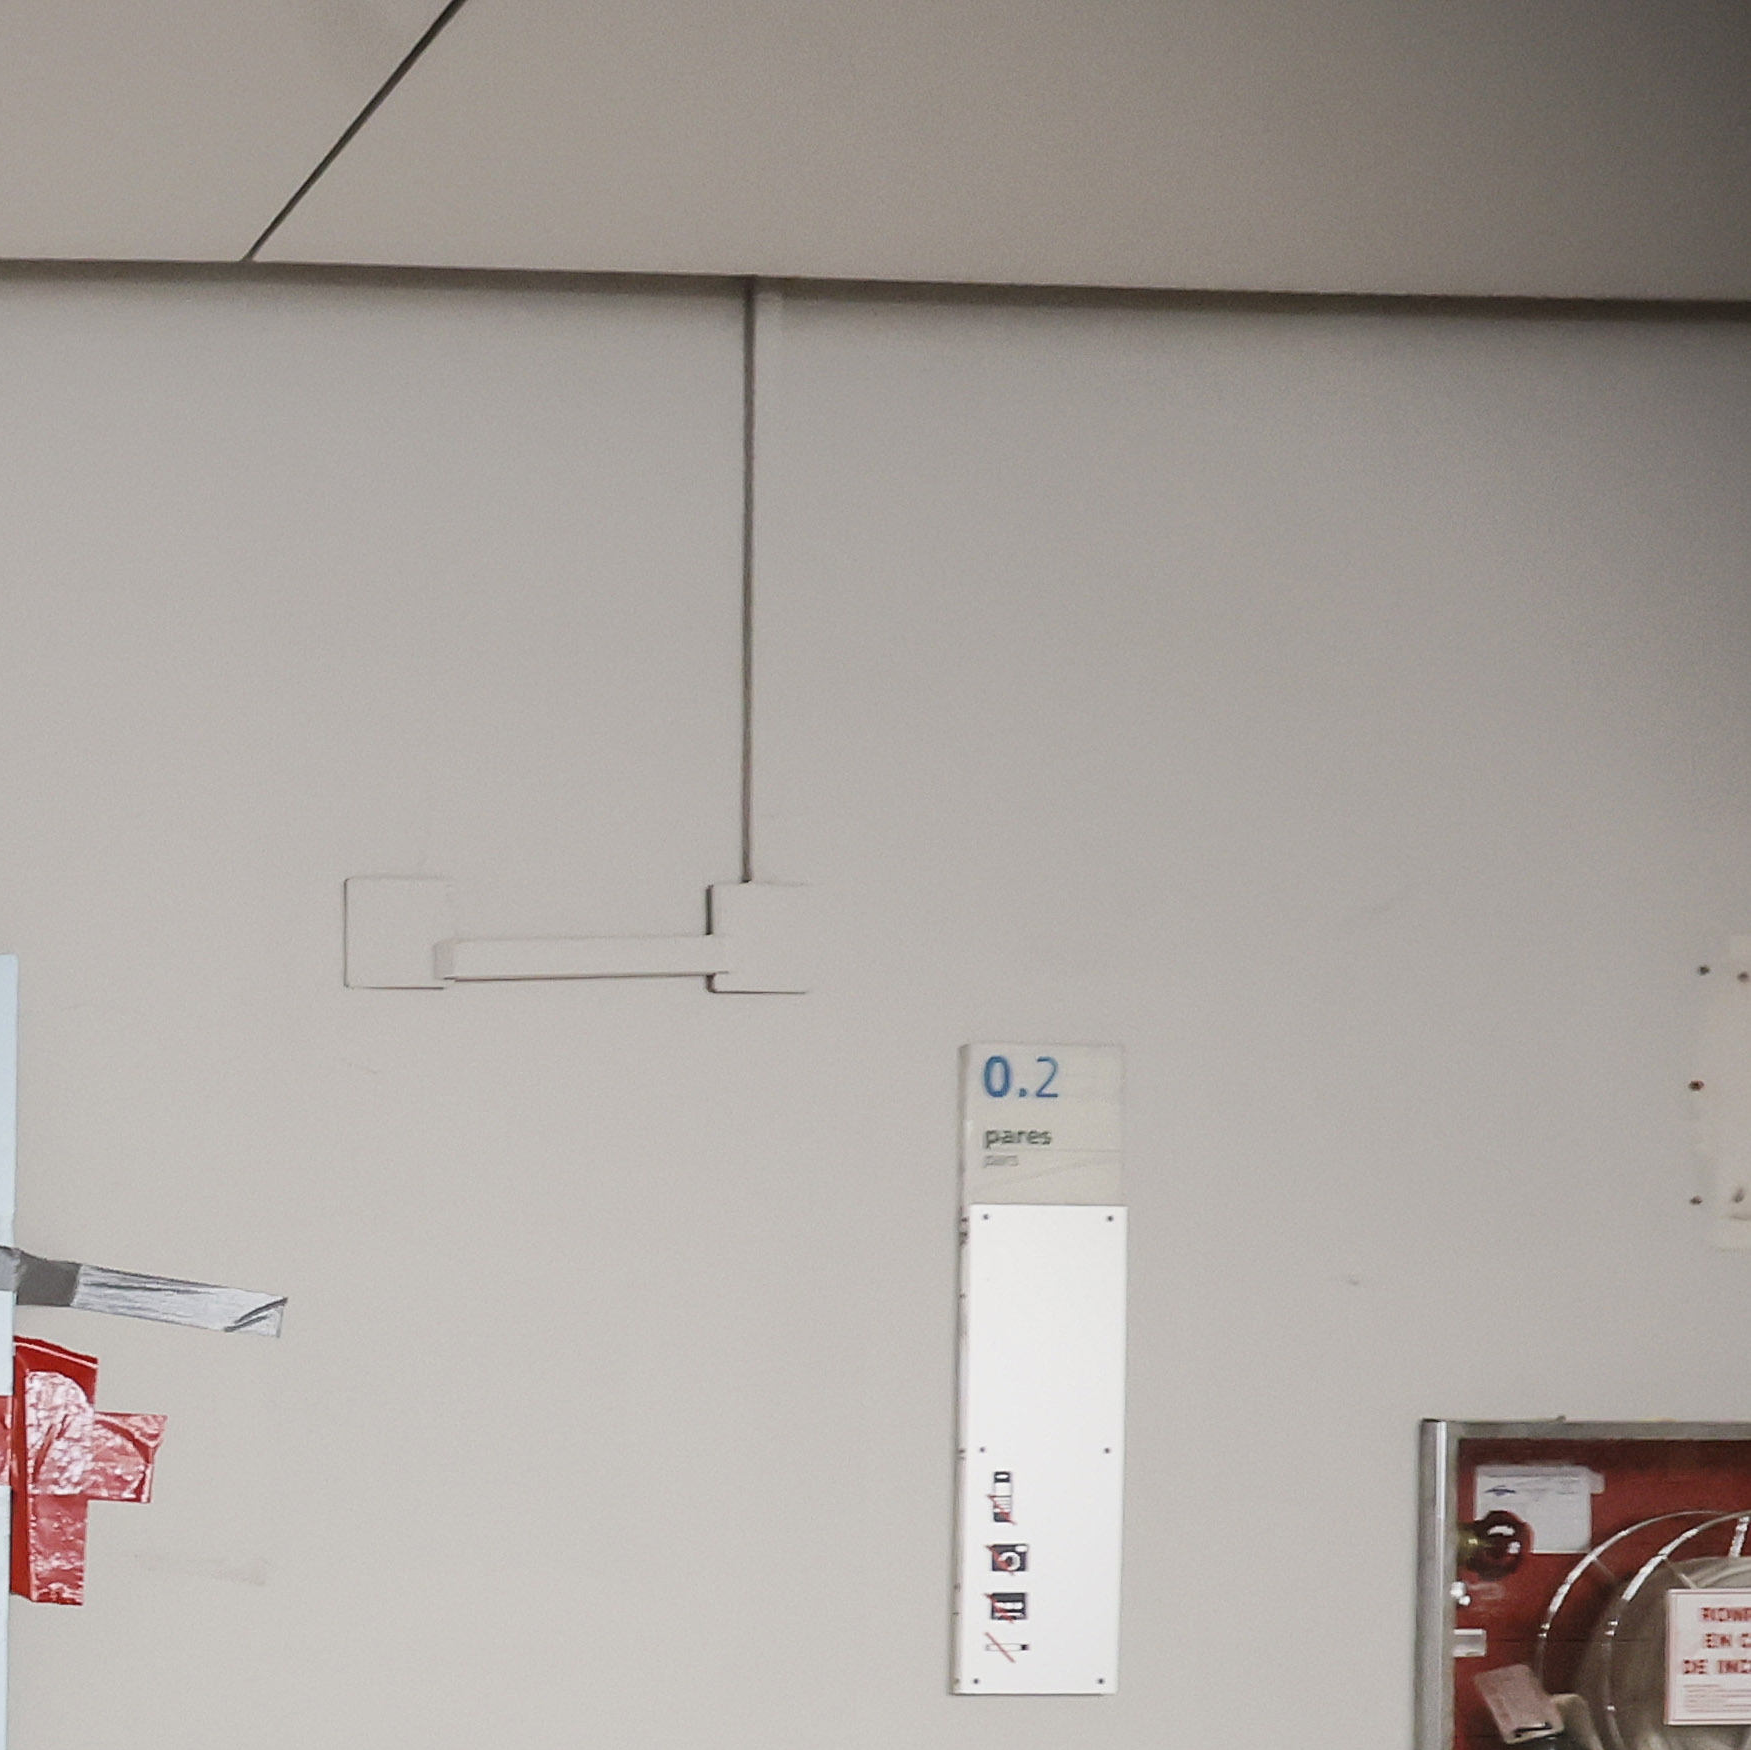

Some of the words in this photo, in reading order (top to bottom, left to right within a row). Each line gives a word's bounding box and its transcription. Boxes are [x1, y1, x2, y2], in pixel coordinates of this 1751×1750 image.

[983, 1054, 1059, 1098] 0.2
[984, 1128, 1052, 1149] pares
[1683, 1659, 1708, 1675] DE
